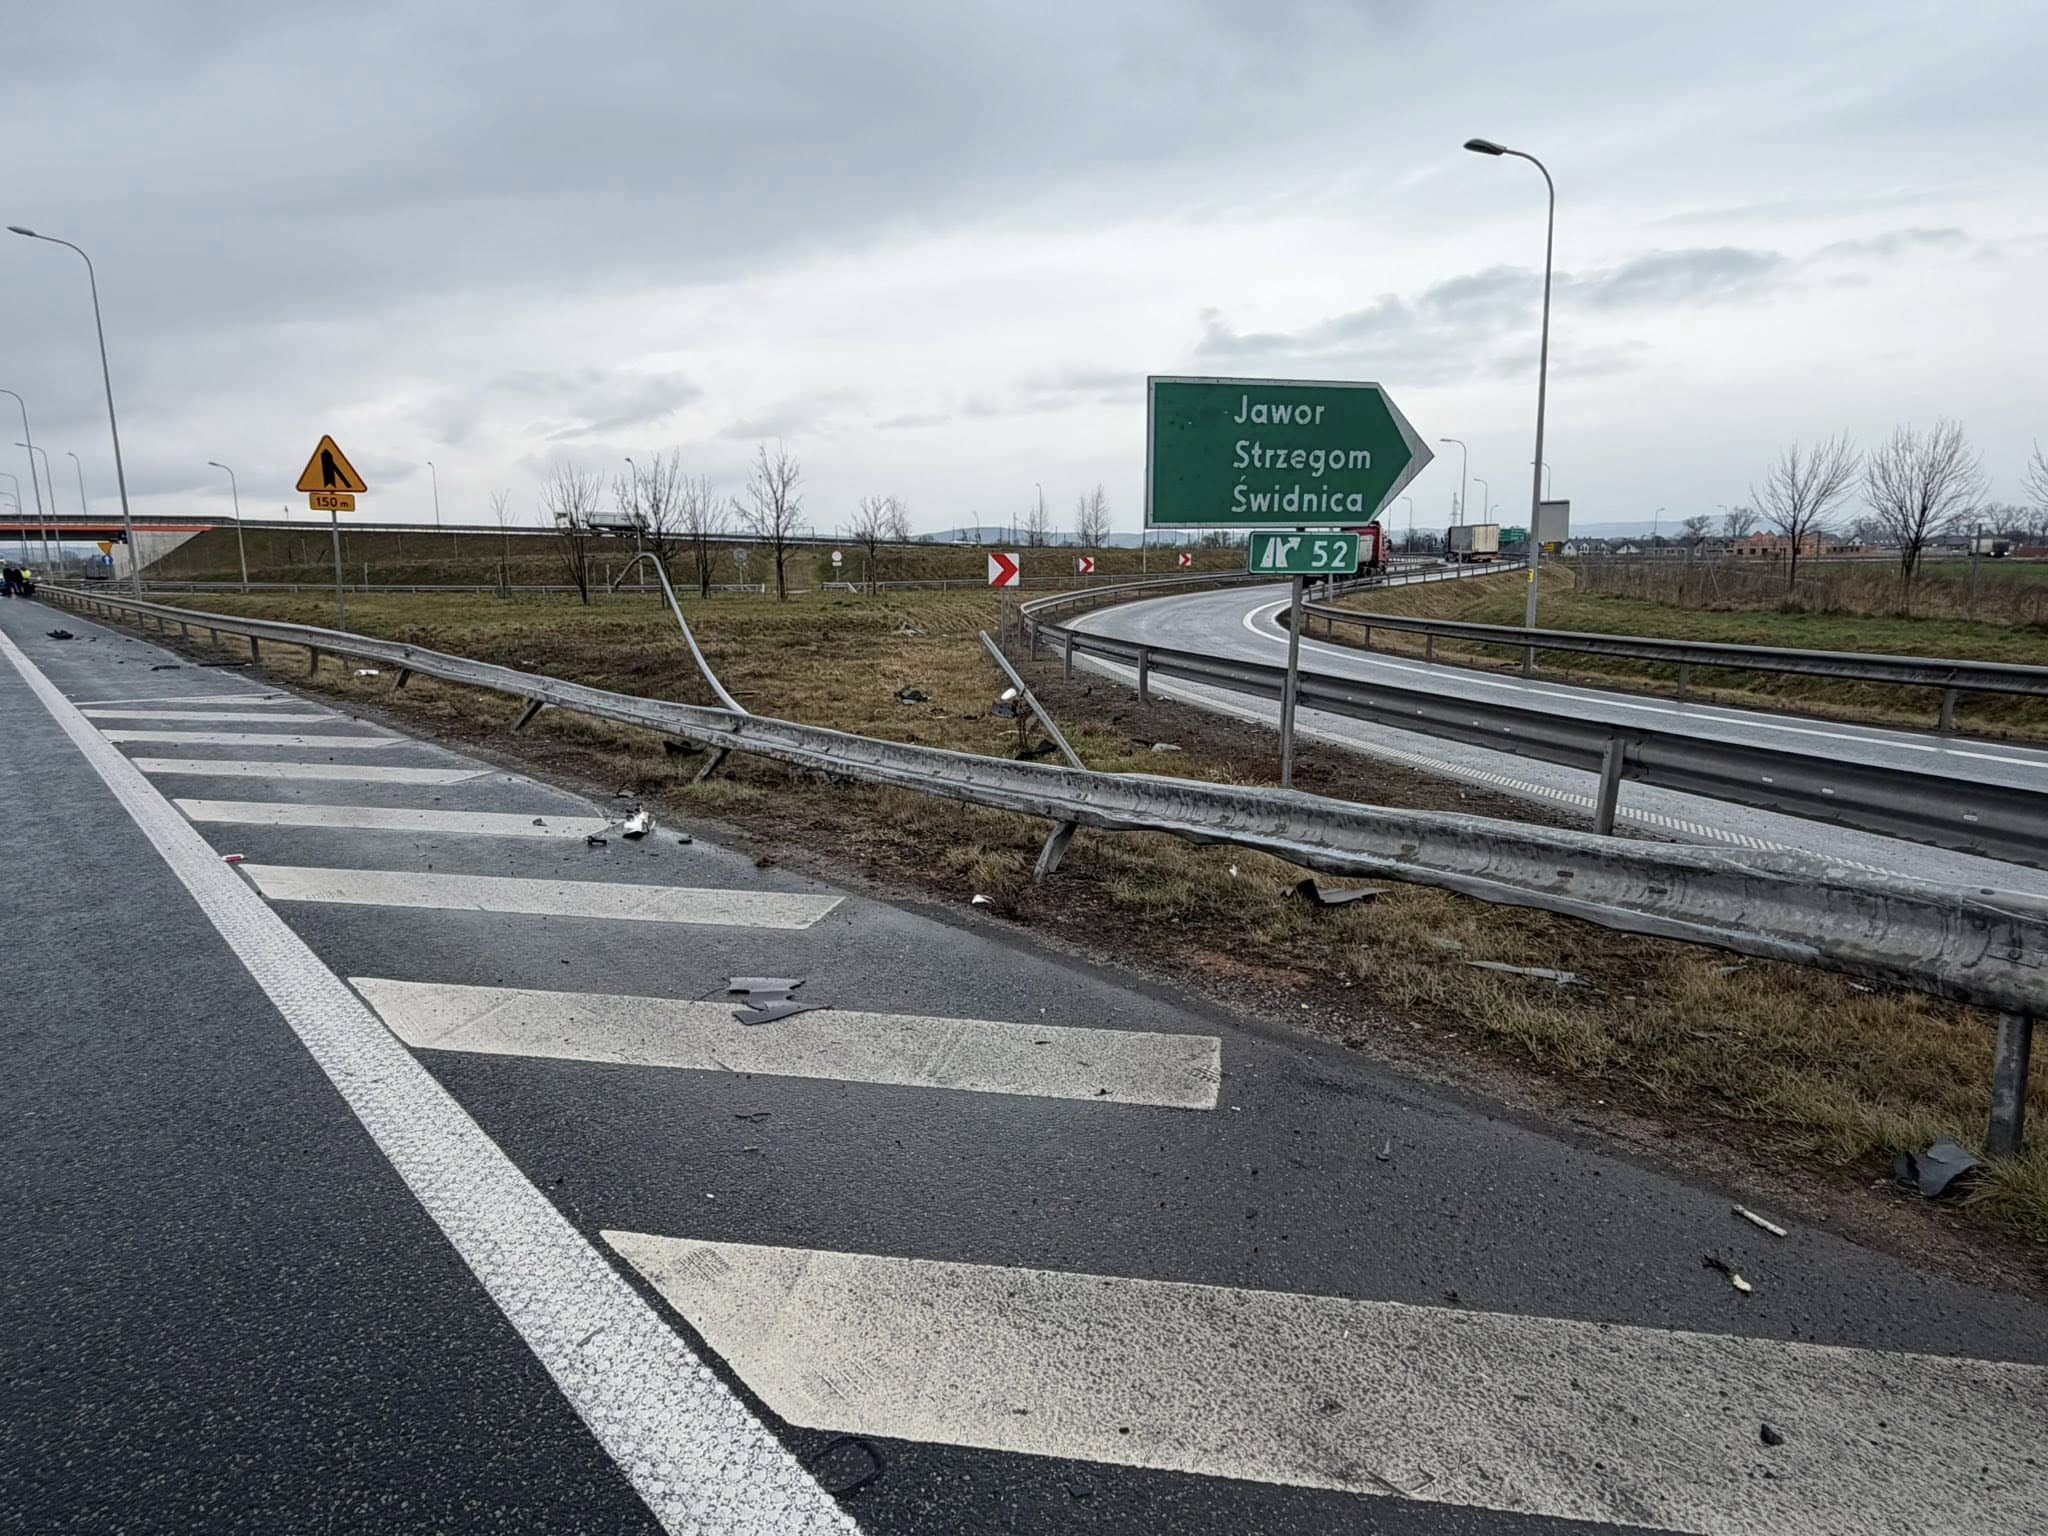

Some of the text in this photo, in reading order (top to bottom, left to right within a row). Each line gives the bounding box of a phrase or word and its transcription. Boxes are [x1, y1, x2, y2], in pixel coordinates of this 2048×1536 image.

[1234, 395, 1325, 425] Jawor
[1233, 440, 1371, 477] Strzegom
[316, 497, 338, 507] 150
[1232, 475, 1362, 513] Świdnica
[1311, 540, 1347, 568] 52
